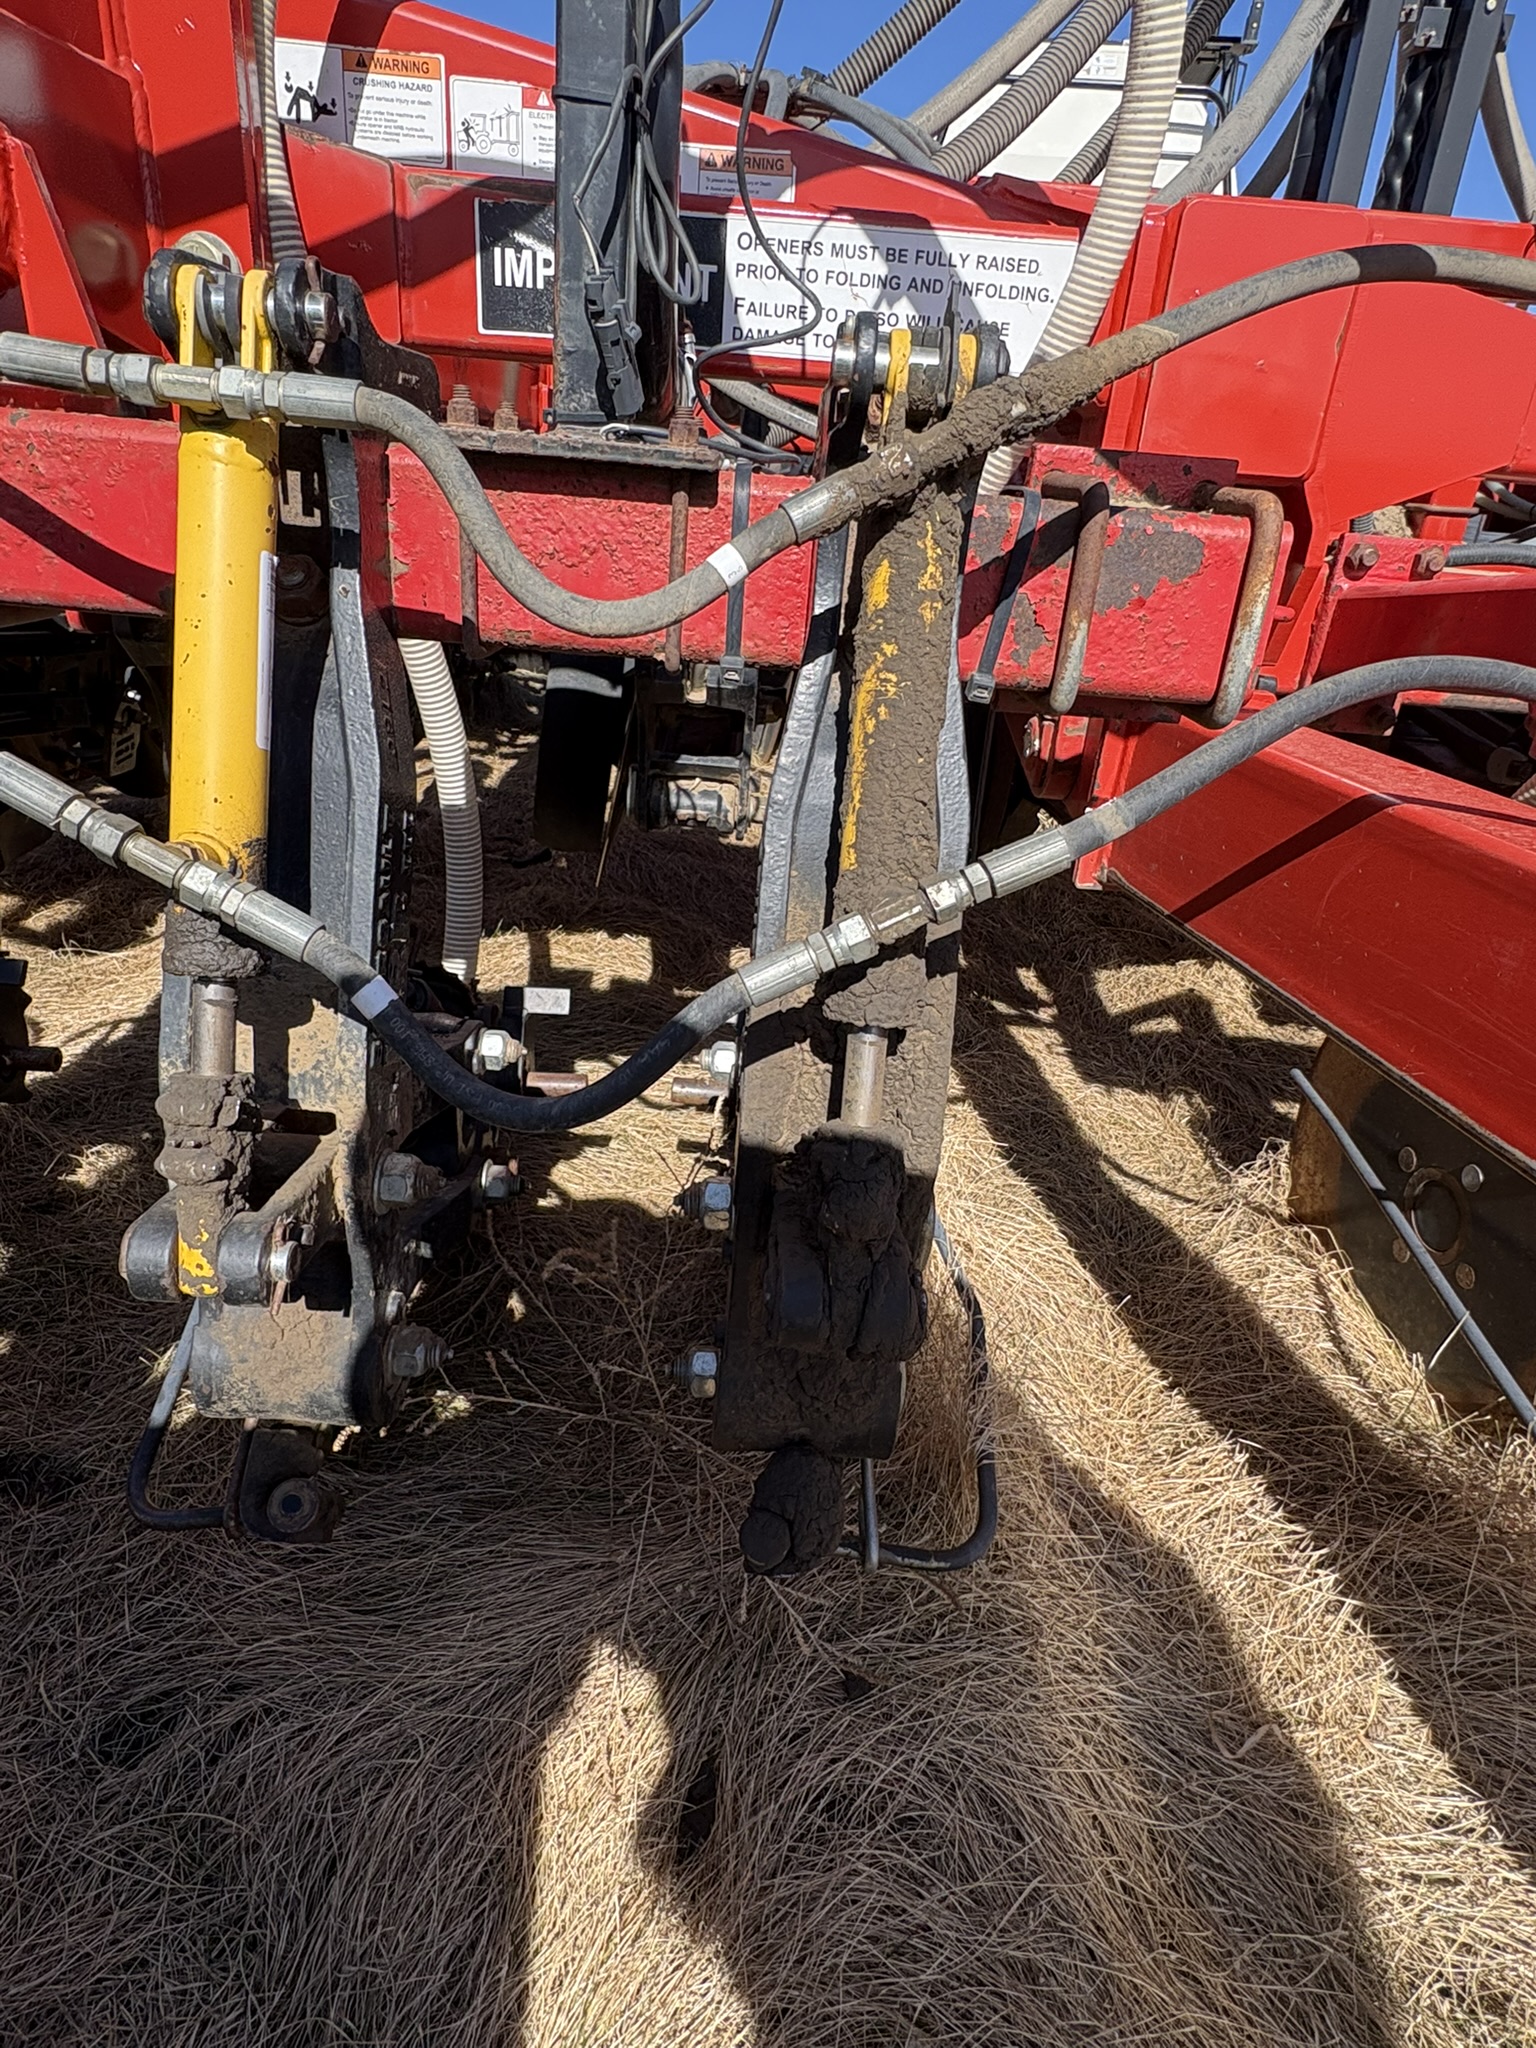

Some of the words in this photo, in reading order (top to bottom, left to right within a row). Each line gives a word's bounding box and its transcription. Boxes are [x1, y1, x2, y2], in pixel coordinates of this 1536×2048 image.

[372, 57, 430, 74] WARNING
[352, 77, 396, 89] CRUSHING
[398, 82, 433, 93] HAZARD
[830, 243, 880, 262] MUST
[885, 247, 909, 264] BE
[914, 249, 971, 269] FULLY
[796, 267, 819, 283] TO
[825, 270, 901, 291] FOLDING
[906, 276, 944, 294] AND
[733, 297, 809, 320] FAILURE
[821, 307, 838, 322] O
[876, 311, 899, 327] SO
[812, 333, 835, 348] TO
